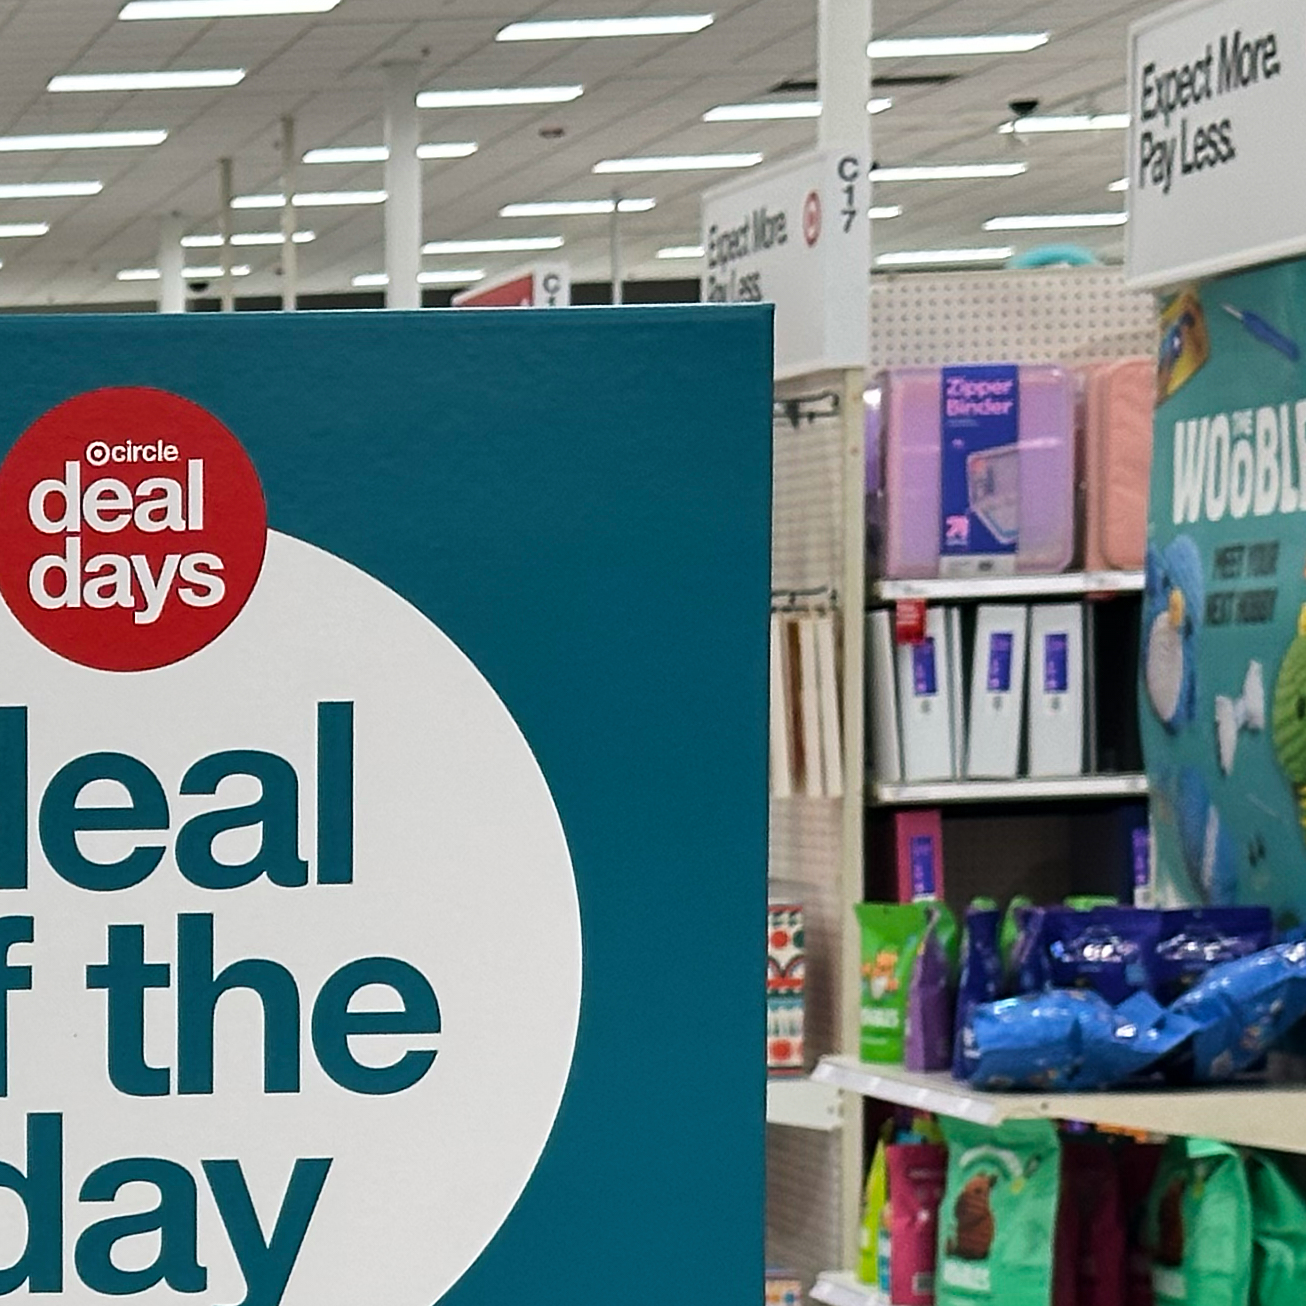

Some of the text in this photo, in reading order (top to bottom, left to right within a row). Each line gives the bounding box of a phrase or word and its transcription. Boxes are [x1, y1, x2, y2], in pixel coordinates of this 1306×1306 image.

[1141, 44, 1213, 127] Expect
[1139, 131, 1178, 195] Pay
[945, 376, 1014, 399] Zipper
[945, 398, 1014, 417] Binder
[111, 439, 180, 463] circle
[28, 458, 204, 534] deal
[28, 536, 226, 625] days
[85, 912, 443, 1097] the
